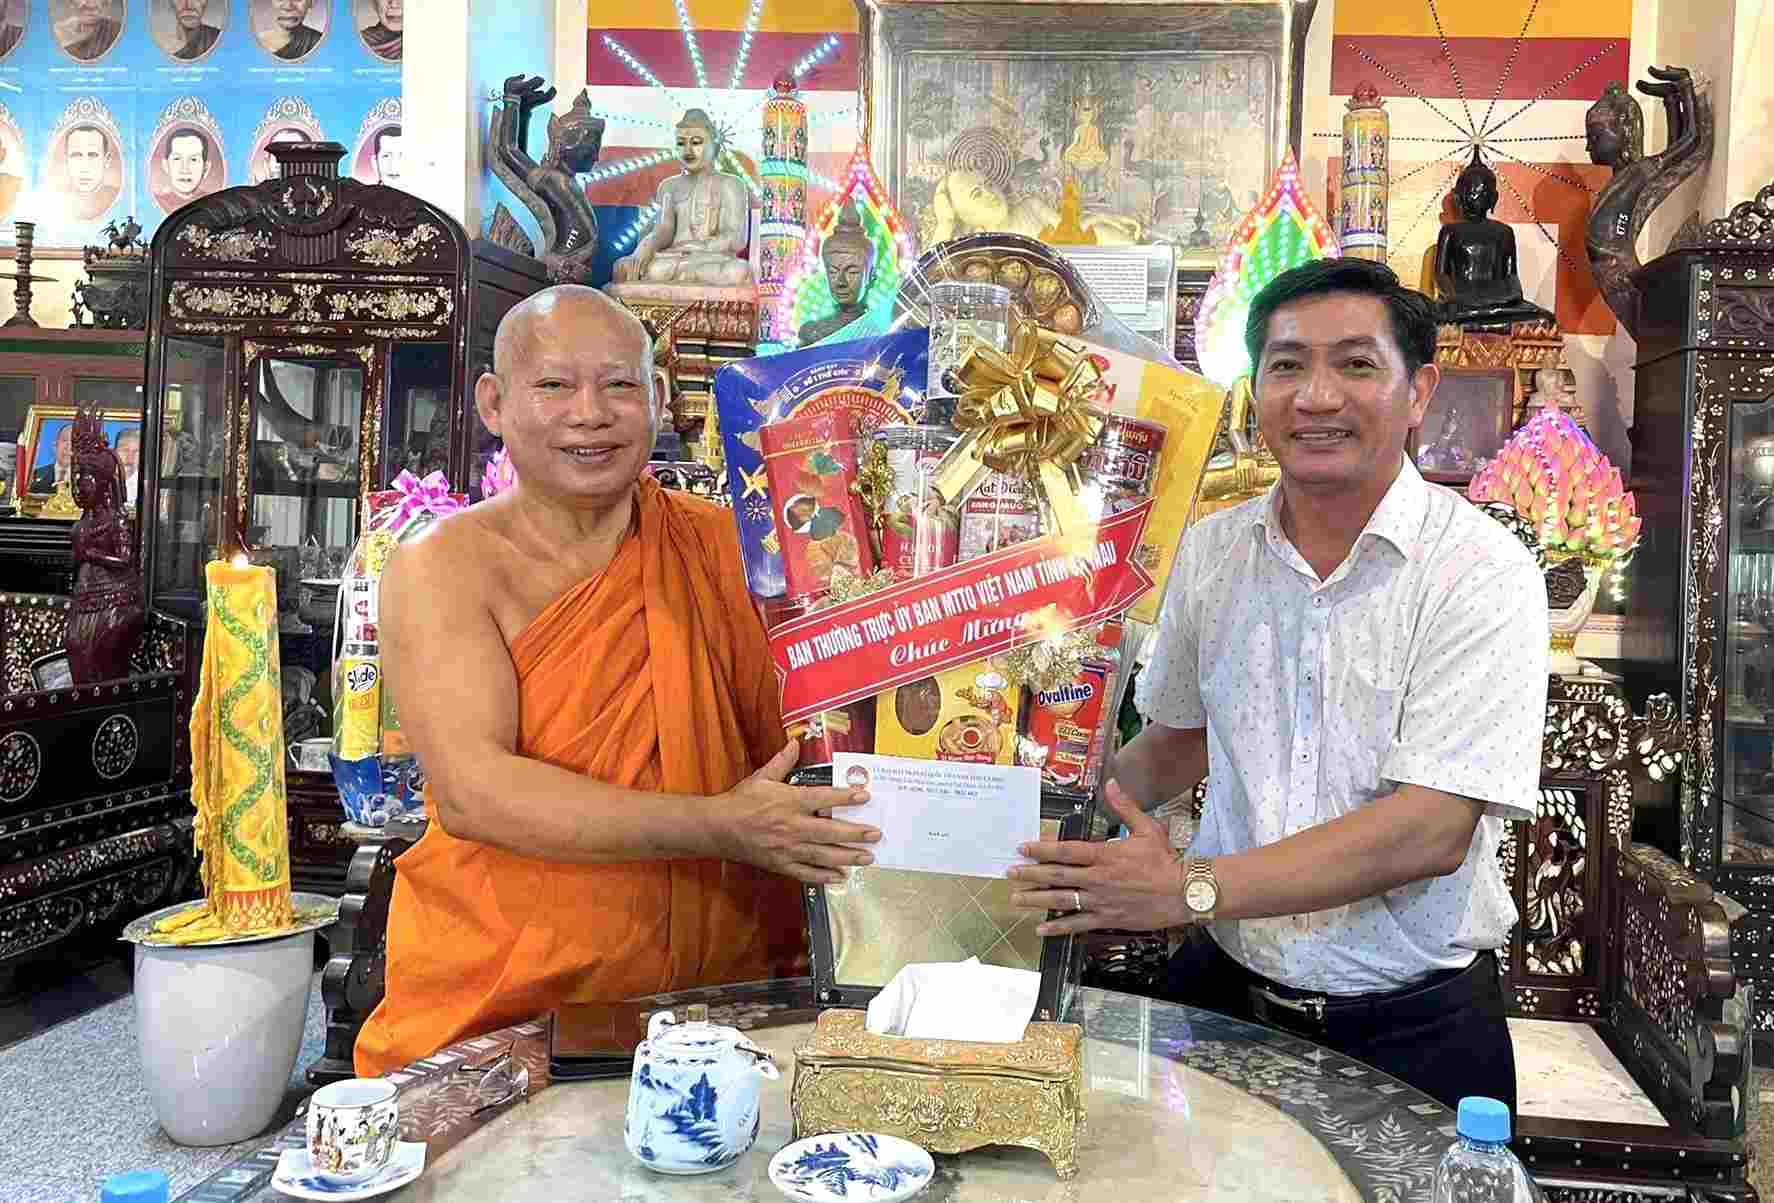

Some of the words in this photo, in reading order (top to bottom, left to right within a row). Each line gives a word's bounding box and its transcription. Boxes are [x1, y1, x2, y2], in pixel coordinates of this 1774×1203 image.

[786, 640, 815, 670] BAN
[812, 622, 865, 662] THƯỜNG
[860, 611, 897, 644] TRỰC
[894, 601, 914, 632] ỦY
[912, 596, 943, 626] BAN
[975, 573, 1004, 607] VIỆT
[1003, 565, 1038, 596] NAM
[889, 638, 951, 667] Chúc
[347, 667, 375, 691] Slide
[1038, 683, 1093, 706] Ovaltine
